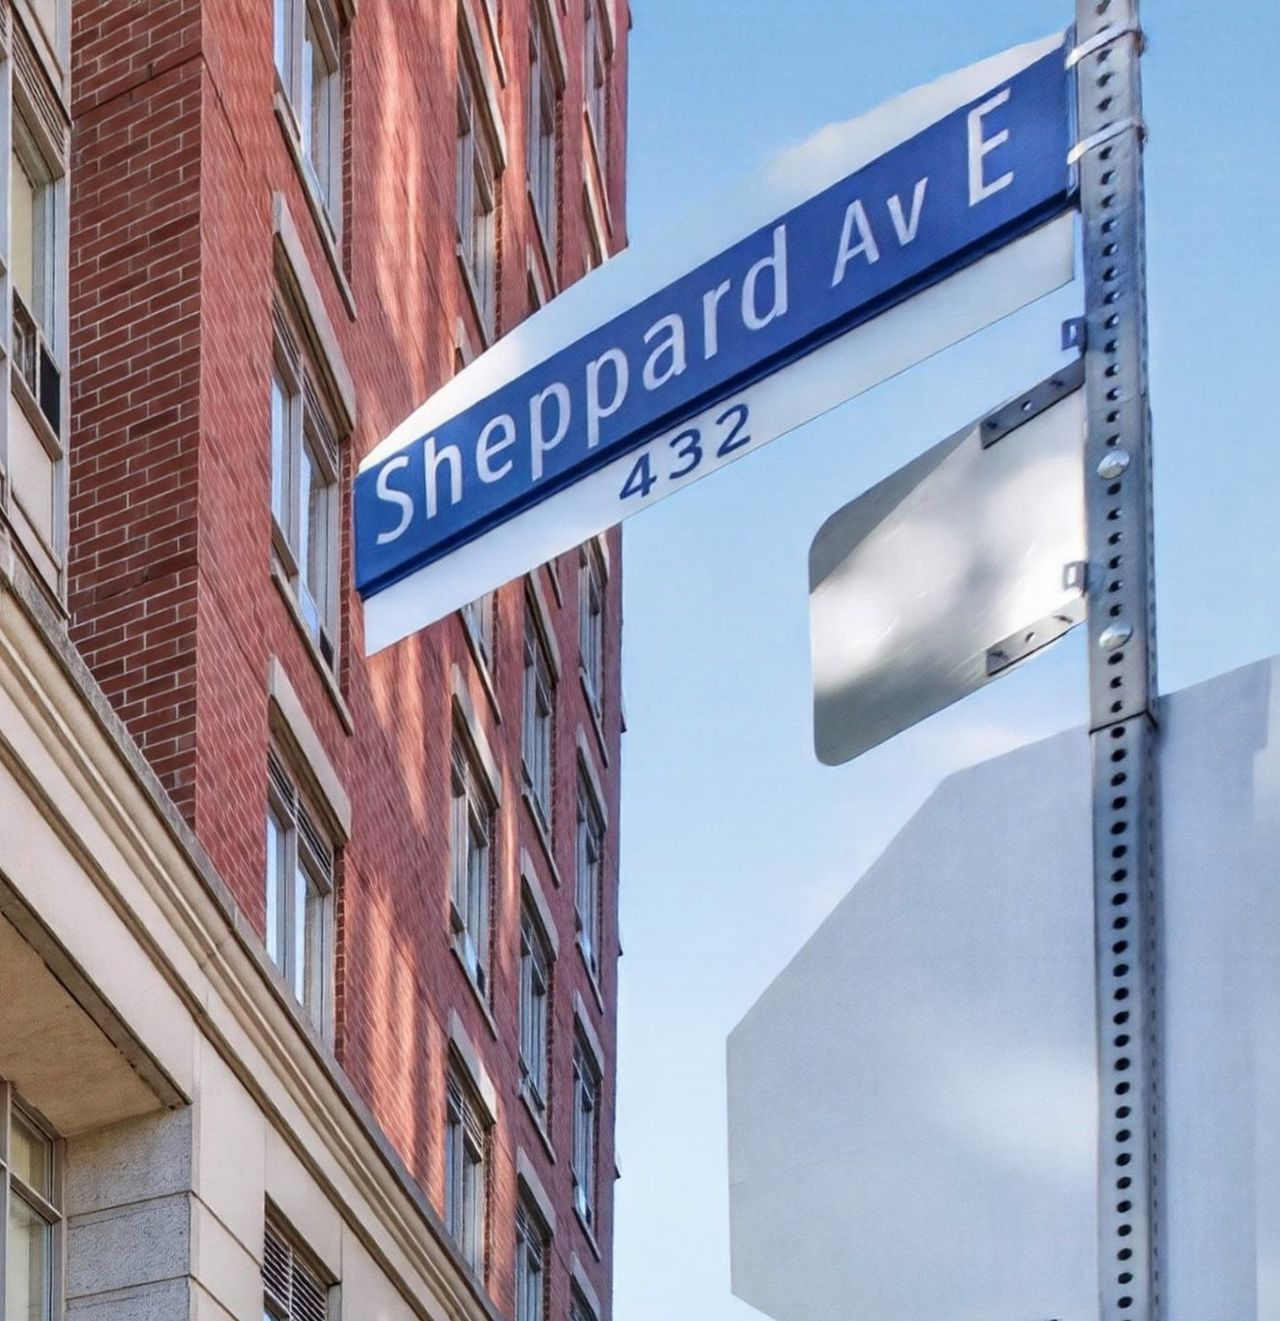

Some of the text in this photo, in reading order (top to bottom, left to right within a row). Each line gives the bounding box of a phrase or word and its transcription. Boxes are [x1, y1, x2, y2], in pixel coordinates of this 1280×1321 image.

[375, 88, 1014, 545] Sheppard Av E
[618, 403, 753, 500] 432
